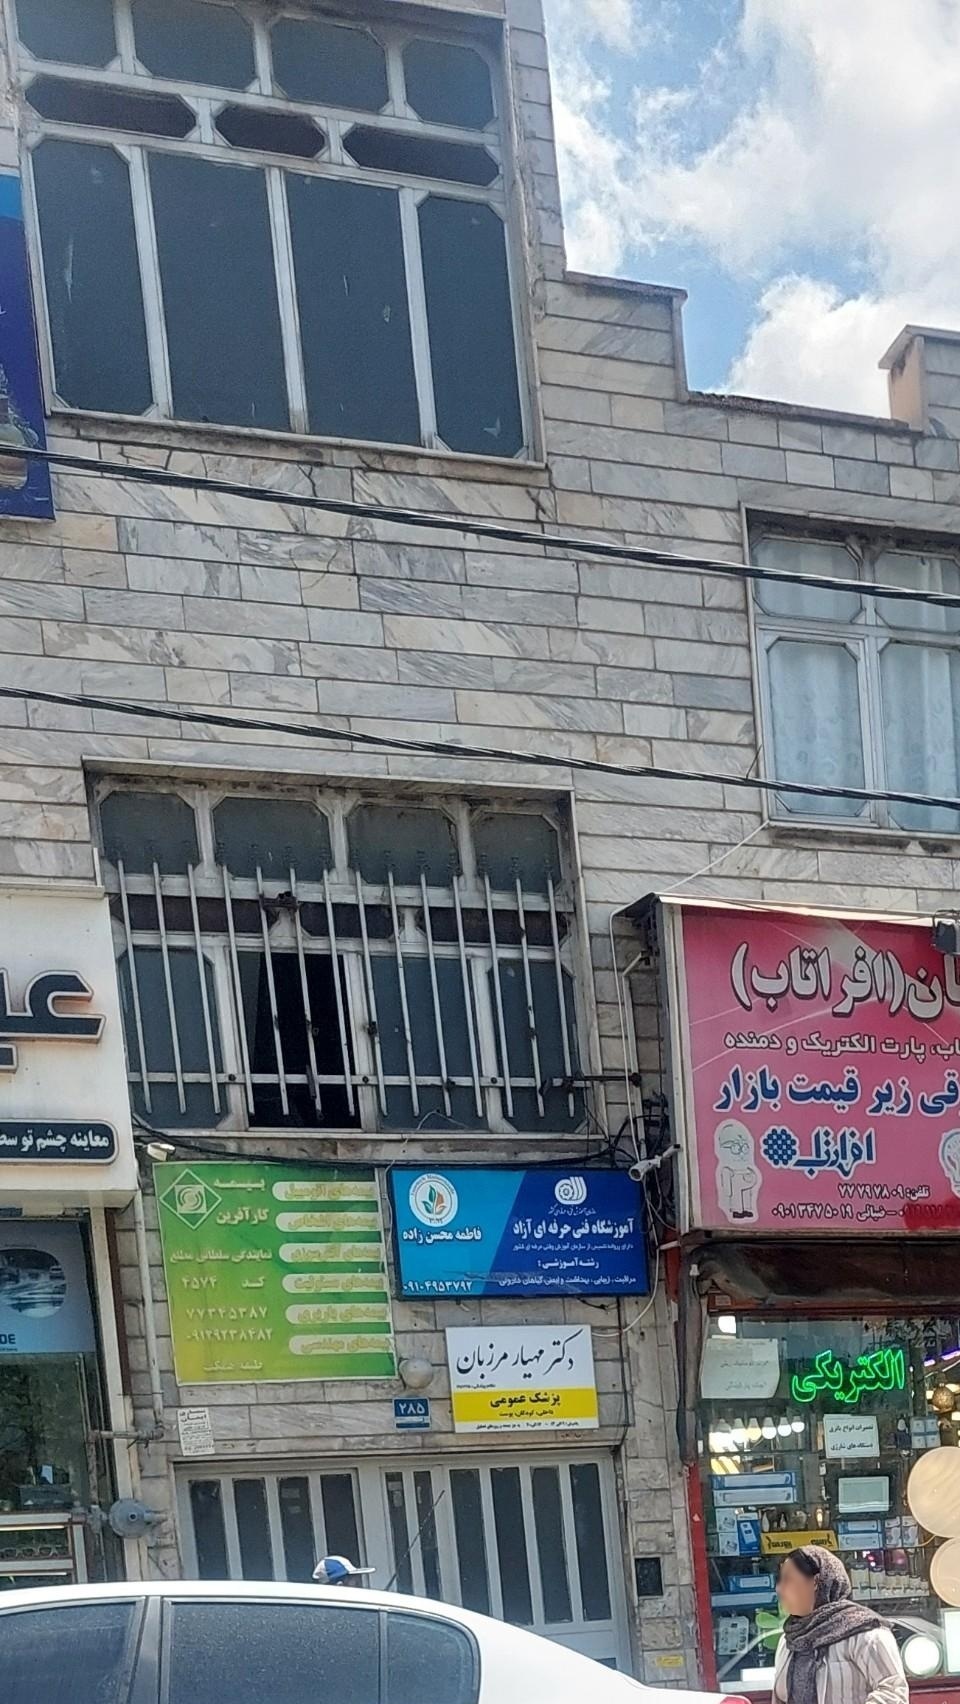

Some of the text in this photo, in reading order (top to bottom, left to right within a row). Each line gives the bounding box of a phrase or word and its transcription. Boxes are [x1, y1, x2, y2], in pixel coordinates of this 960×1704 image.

[724, 1032, 782, 1050] دمنده
[786, 1036, 799, 1056] و
[801, 1032, 876, 1057] الکتریک
[881, 1035, 926, 1063] پارت
[713, 1064, 781, 1113] بازار
[787, 1066, 861, 1114] قیمت
[868, 1076, 911, 1116] زیر
[36, 1128, 67, 1152] چشم
[70, 1129, 109, 1151] معاینه
[213, 1177, 265, 1189] بیمه
[403, 1226, 482, 1244] فاطمه محسن زاده
[513, 1218, 634, 1239] آموزشگاه فنی حرفه ای آزاد
[231, 1248, 272, 1263] نمایندگی
[241, 1276, 265, 1288] کد
[456, 1328, 583, 1380] دکتر مهیار مرزبان
[791, 1348, 905, 1403] الکتریکی
[398, 1401, 425, 1414] ۲۸۵
[490, 1392, 562, 1409] پزشک عمومی
